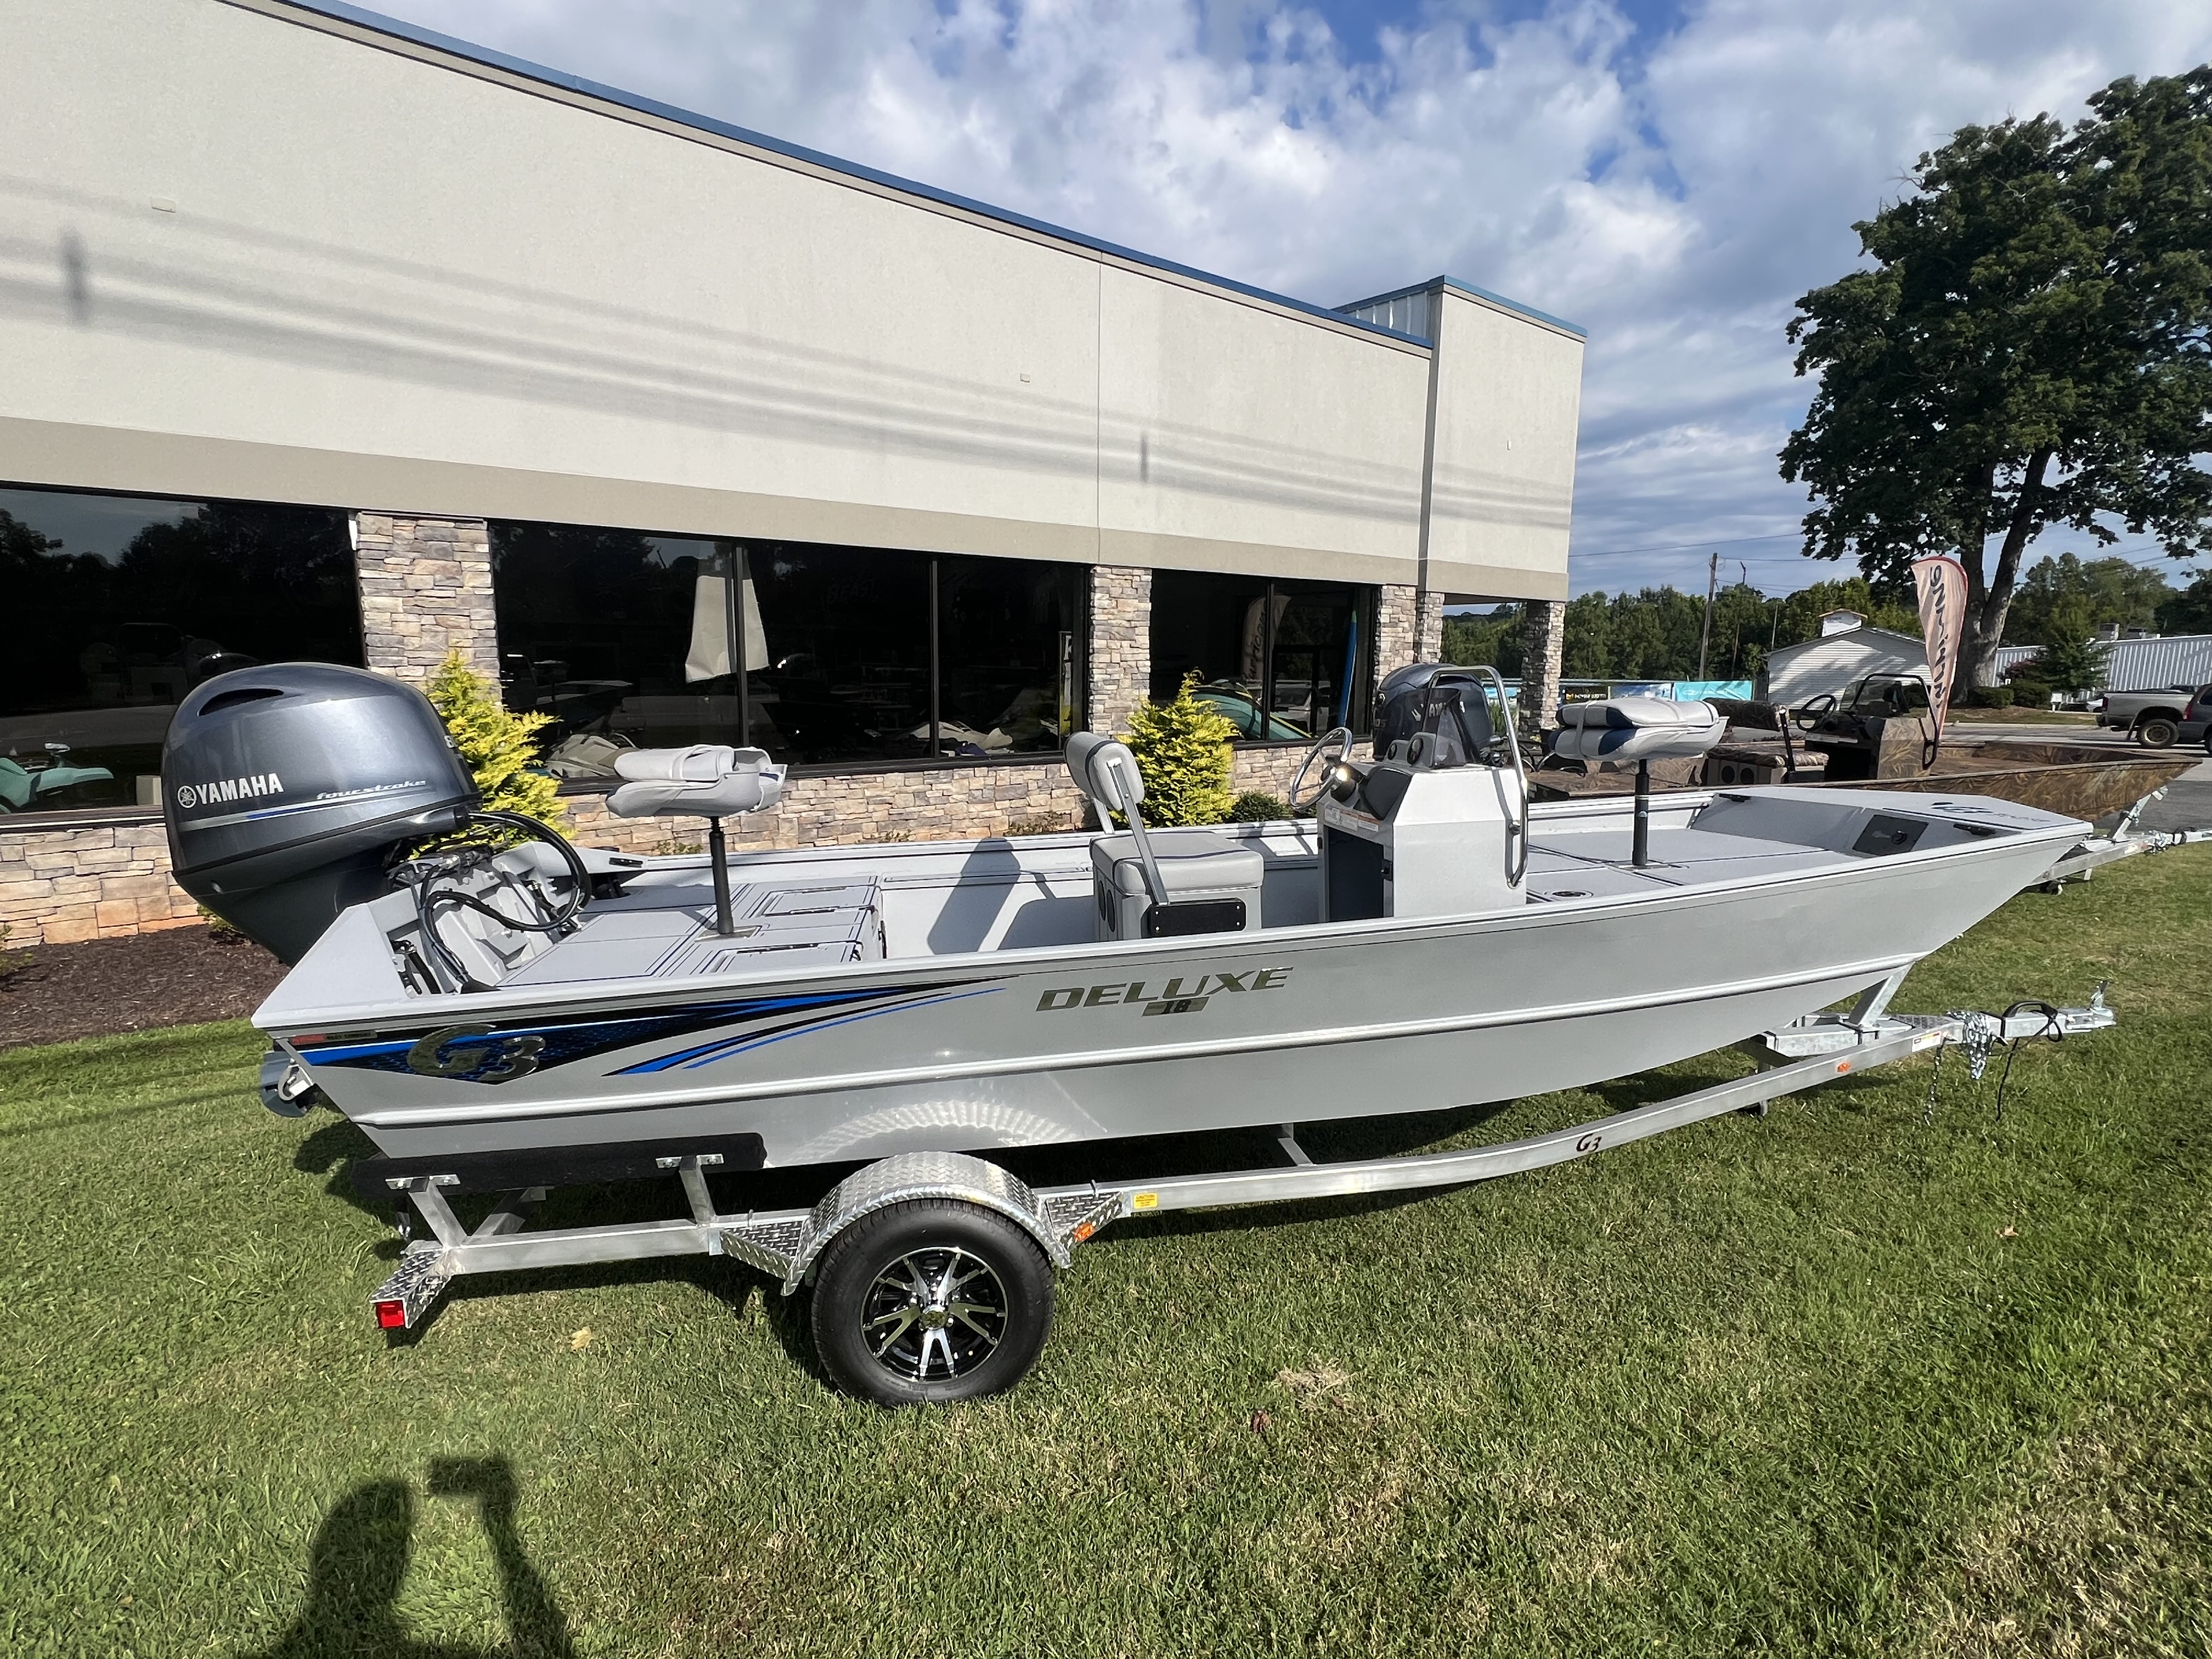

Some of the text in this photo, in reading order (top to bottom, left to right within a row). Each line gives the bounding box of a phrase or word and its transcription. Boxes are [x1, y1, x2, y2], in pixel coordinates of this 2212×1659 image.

[196, 772, 284, 805] YAMAHA
[316, 780, 426, 800] fourstroke
[1035, 967, 1294, 1012] DELUXE
[1161, 998, 1192, 1015] 18
[407, 1023, 546, 1081] G3
[1576, 1133, 1602, 1153] G3
